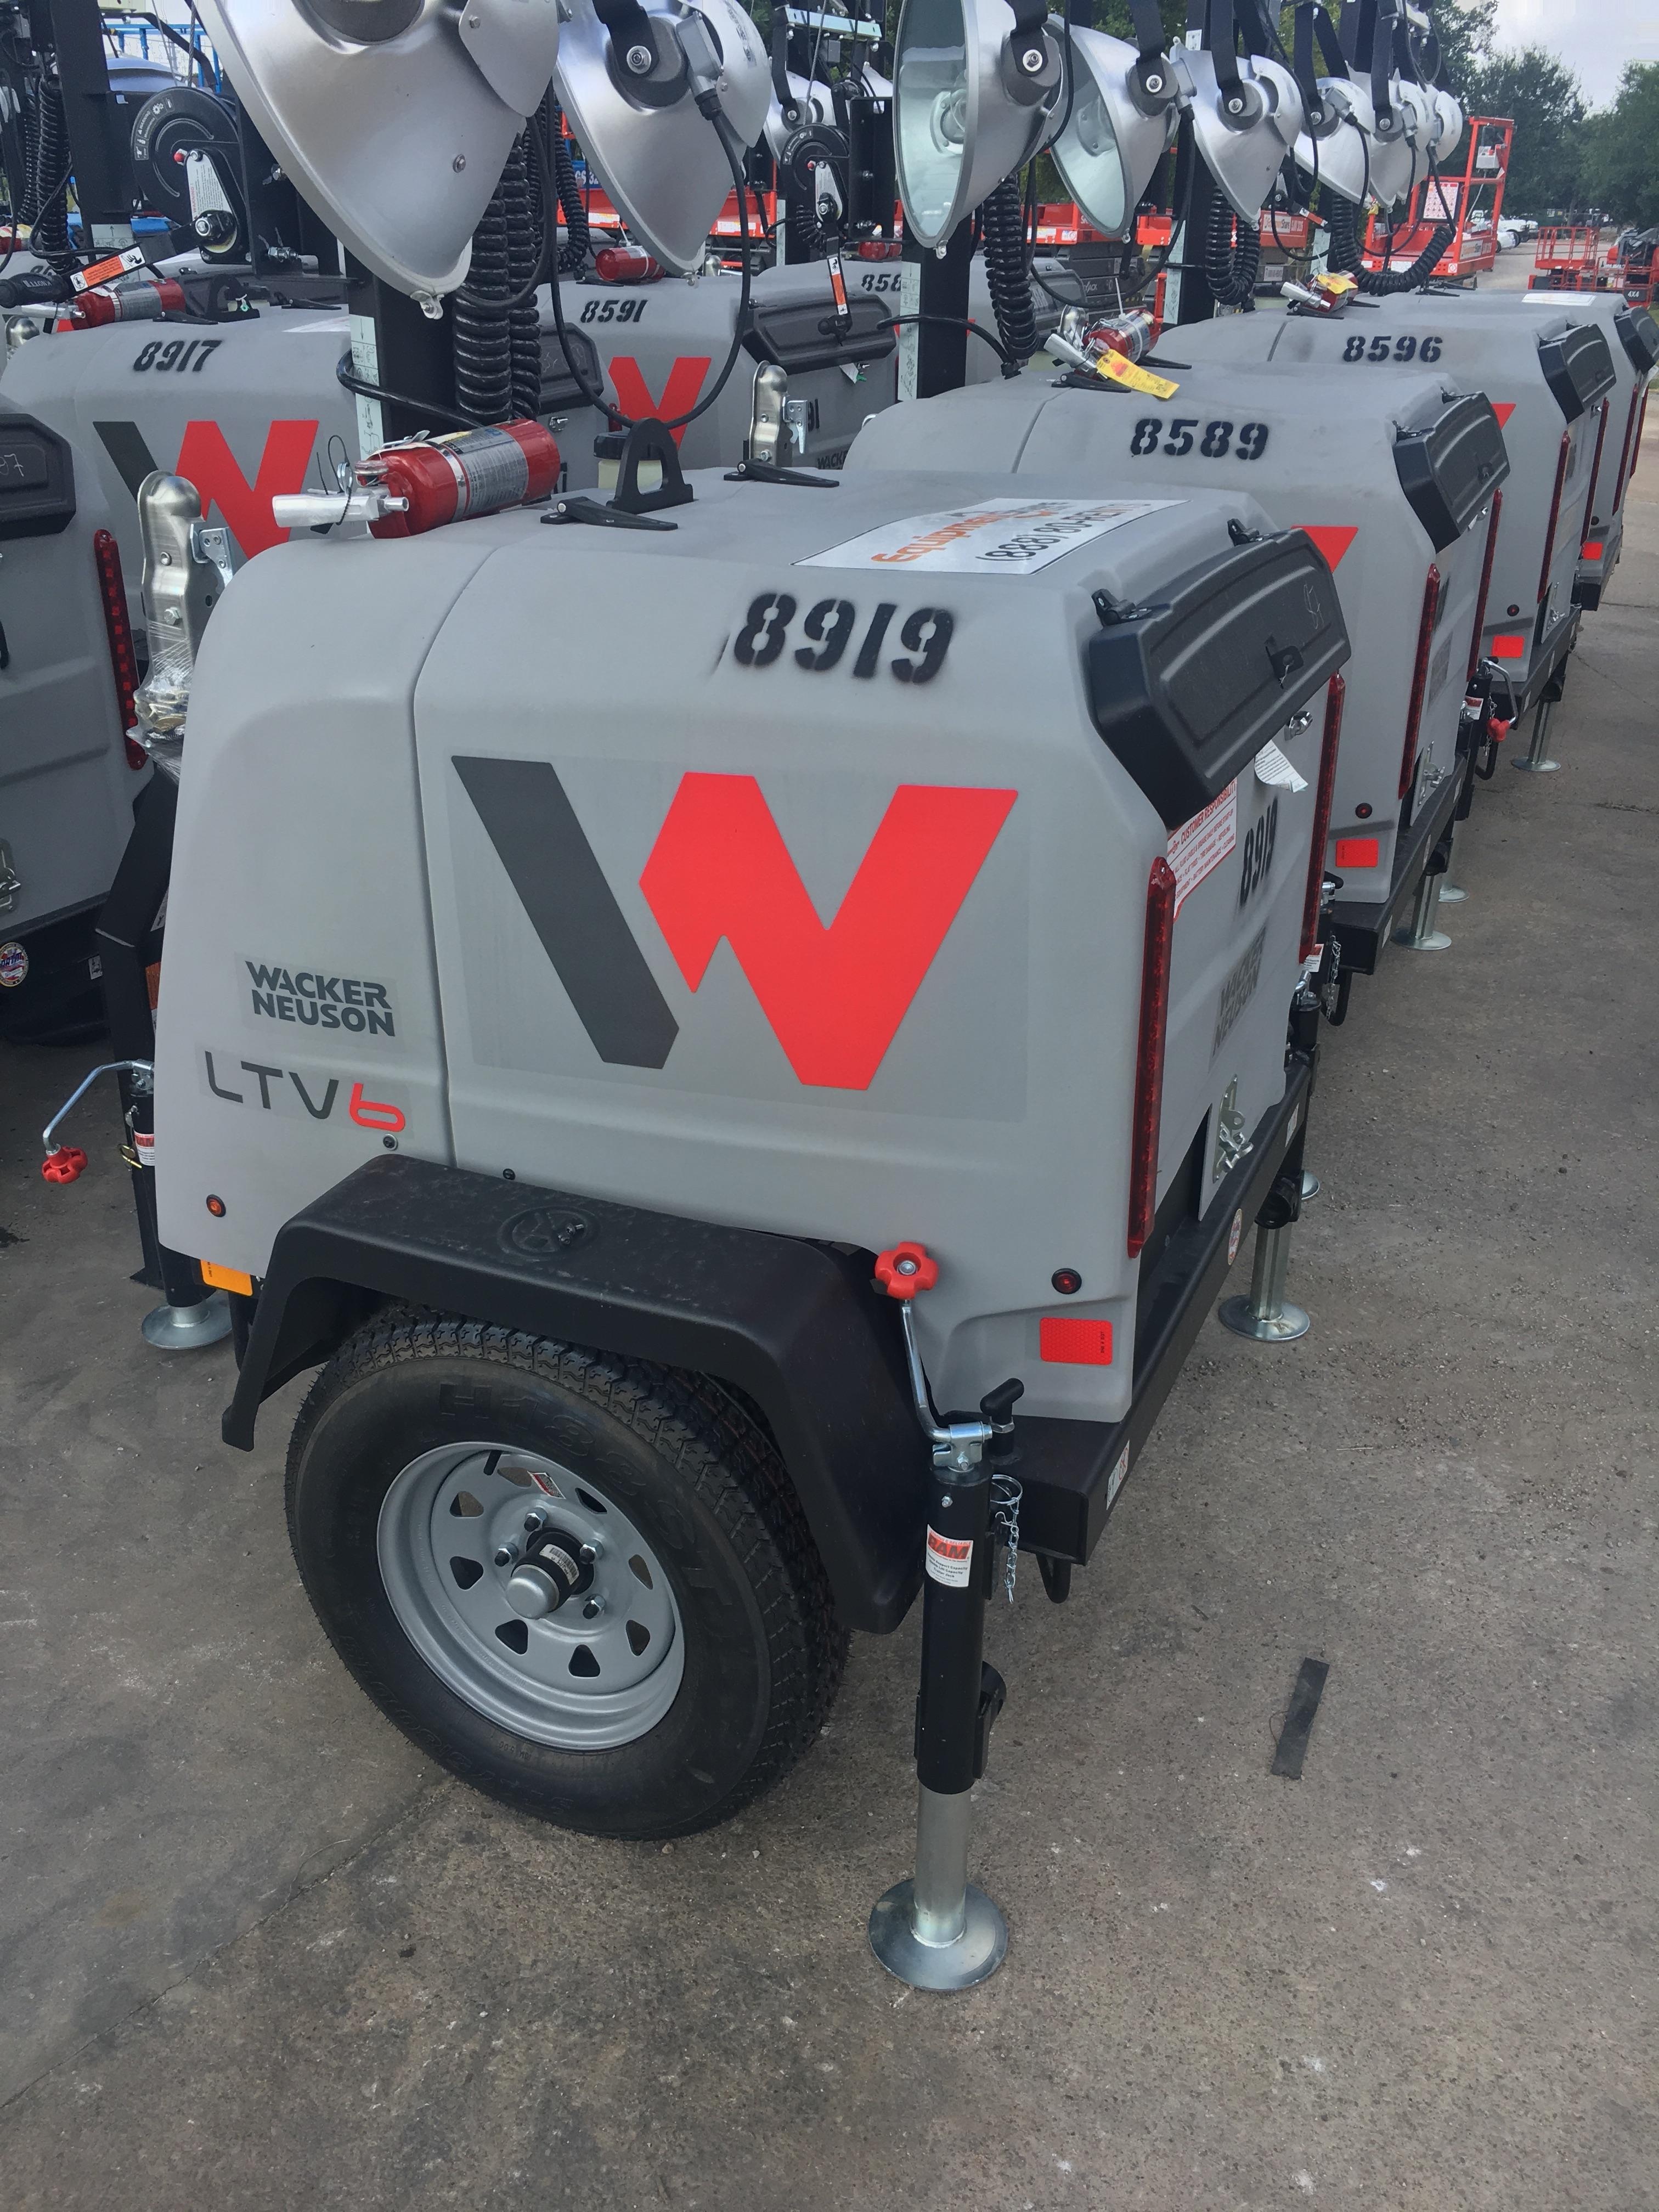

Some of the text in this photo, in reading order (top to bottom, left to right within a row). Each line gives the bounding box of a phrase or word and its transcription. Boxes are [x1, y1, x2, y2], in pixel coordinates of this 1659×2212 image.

[580, 299, 648, 323] 8591
[133, 339, 223, 373] 8917
[1342, 335, 1443, 363] 8596
[1130, 417, 1269, 461] 8589
[975, 534, 1069, 562] (888)
[733, 592, 955, 686] 8919
[1181, 810, 1204, 845] CUSTOMER
[1240, 797, 1278, 909] 8919
[245, 961, 392, 1010] WACKER
[251, 989, 396, 1037] NEUSON
[205, 1051, 404, 1131] LTV6
[928, 1533, 969, 1559] RAM
